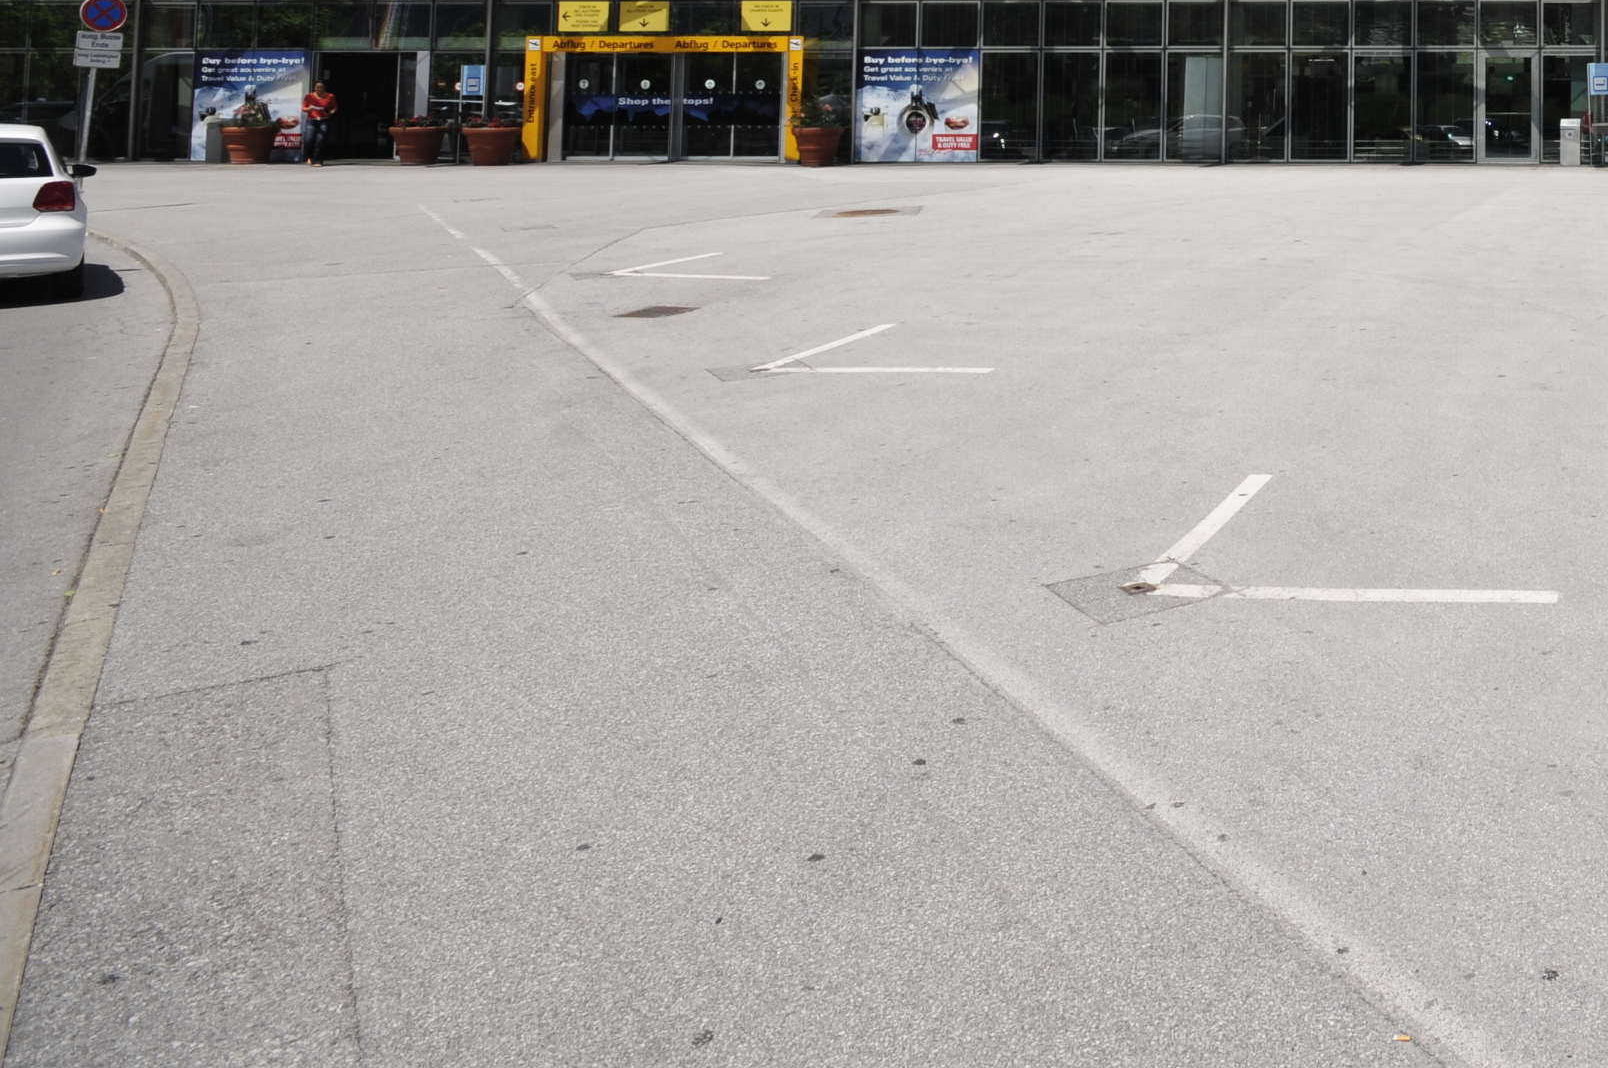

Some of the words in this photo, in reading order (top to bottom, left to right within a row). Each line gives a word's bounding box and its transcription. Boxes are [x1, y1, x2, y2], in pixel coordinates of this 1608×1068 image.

[100, 33, 121, 41] Busse
[552, 40, 586, 50] Abflug
[598, 40, 654, 50] Departures
[675, 40, 709, 50] Abflug
[721, 40, 778, 50] Departures
[202, 57, 221, 65] Buy
[260, 57, 305, 65] bye-bye!
[863, 56, 885, 65] Buy
[887, 56, 923, 64] before
[925, 56, 973, 65] bye-bye!
[217, 66, 238, 74] great
[530, 63, 538, 82] east
[880, 66, 902, 74] great
[790, 62, 799, 103] Check-in
[526, 86, 536, 123] Entrance
[618, 97, 649, 106] Shop
[651, 97, 671, 105] the
[683, 97, 714, 106] tops!
